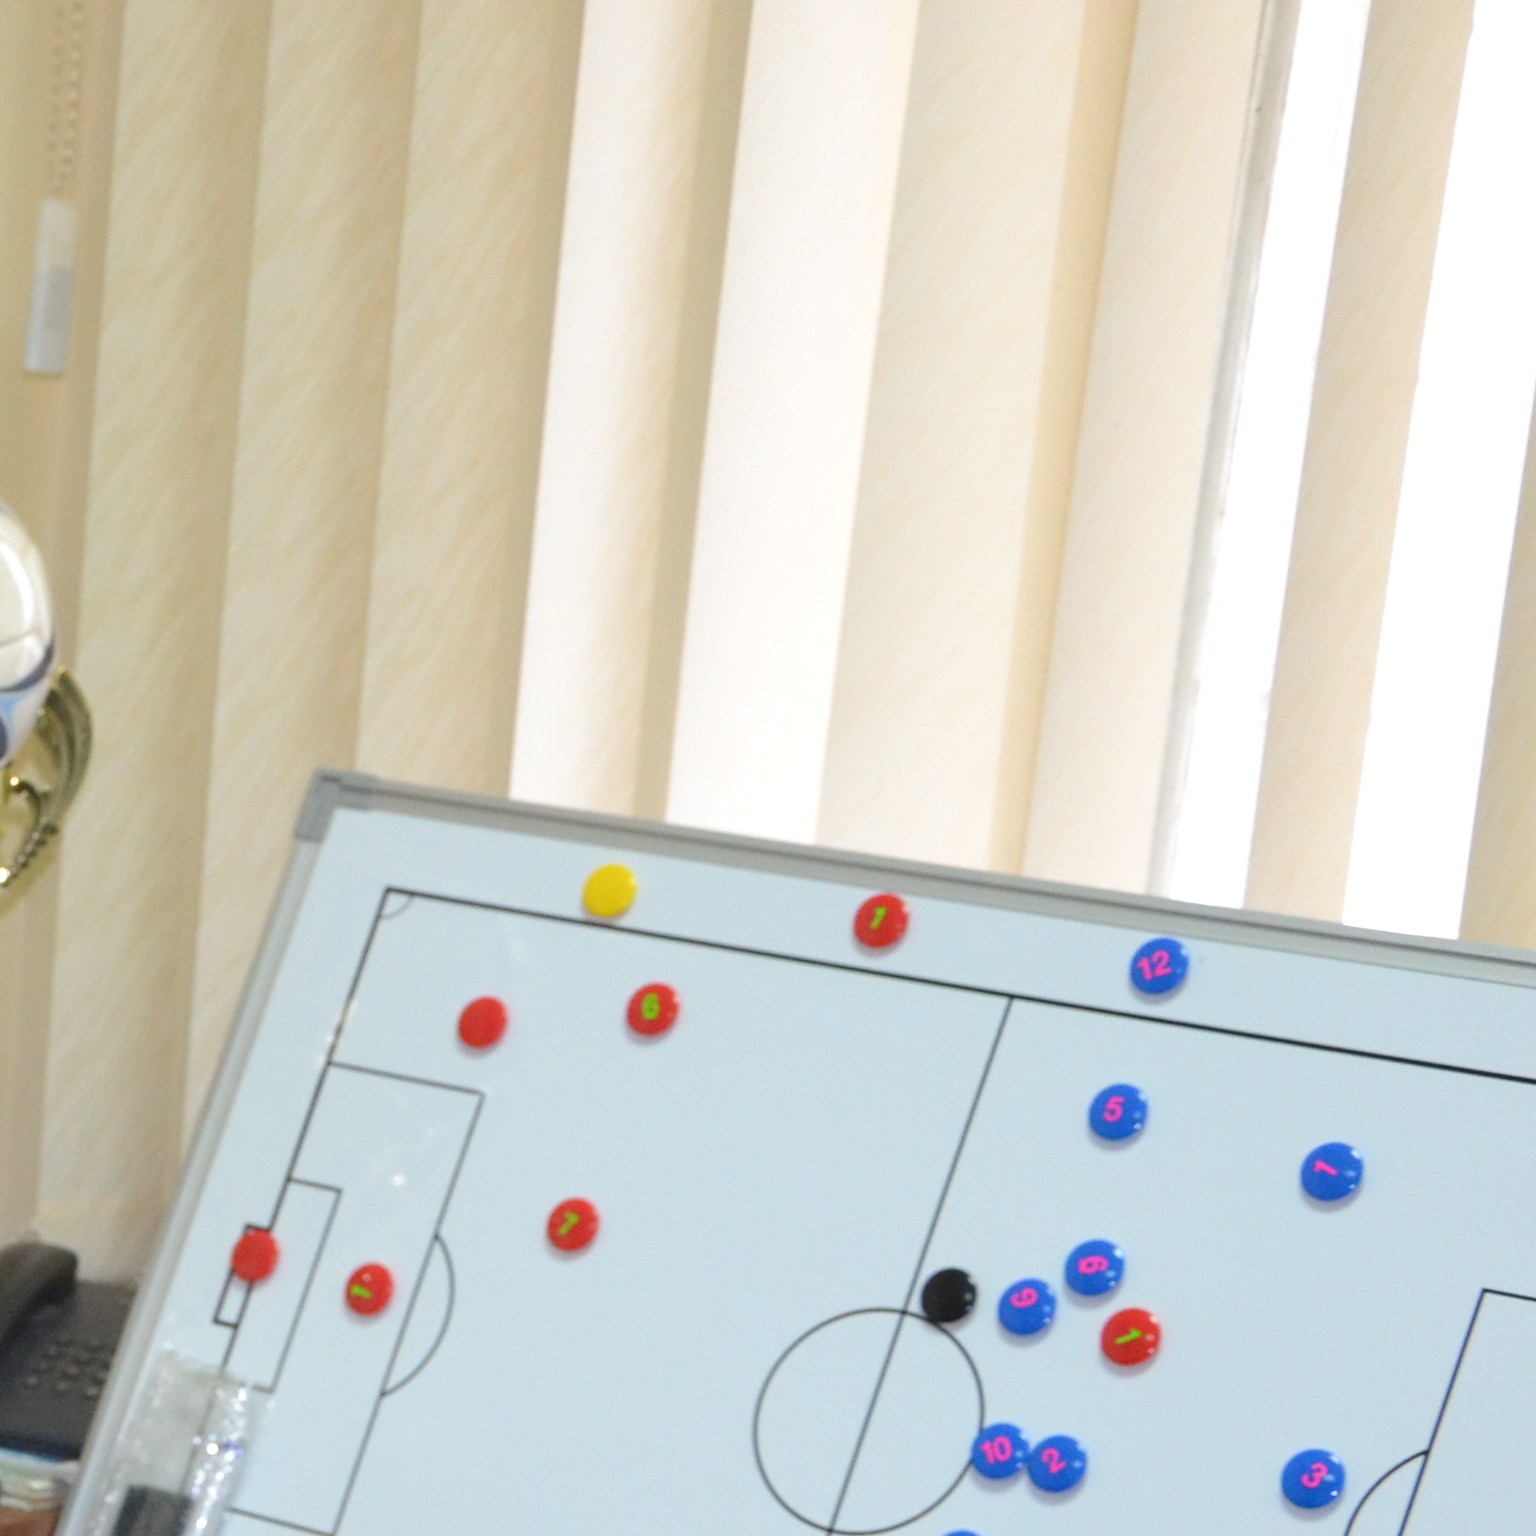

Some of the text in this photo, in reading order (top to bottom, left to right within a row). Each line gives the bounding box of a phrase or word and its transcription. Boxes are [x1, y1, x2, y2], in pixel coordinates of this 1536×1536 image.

[1138, 949, 1172, 980] 12
[1103, 1096, 1127, 1122] 5
[981, 1436, 1013, 1465] 10
[1042, 1448, 1066, 1474] 2
[1301, 1462, 1330, 1490] 3
